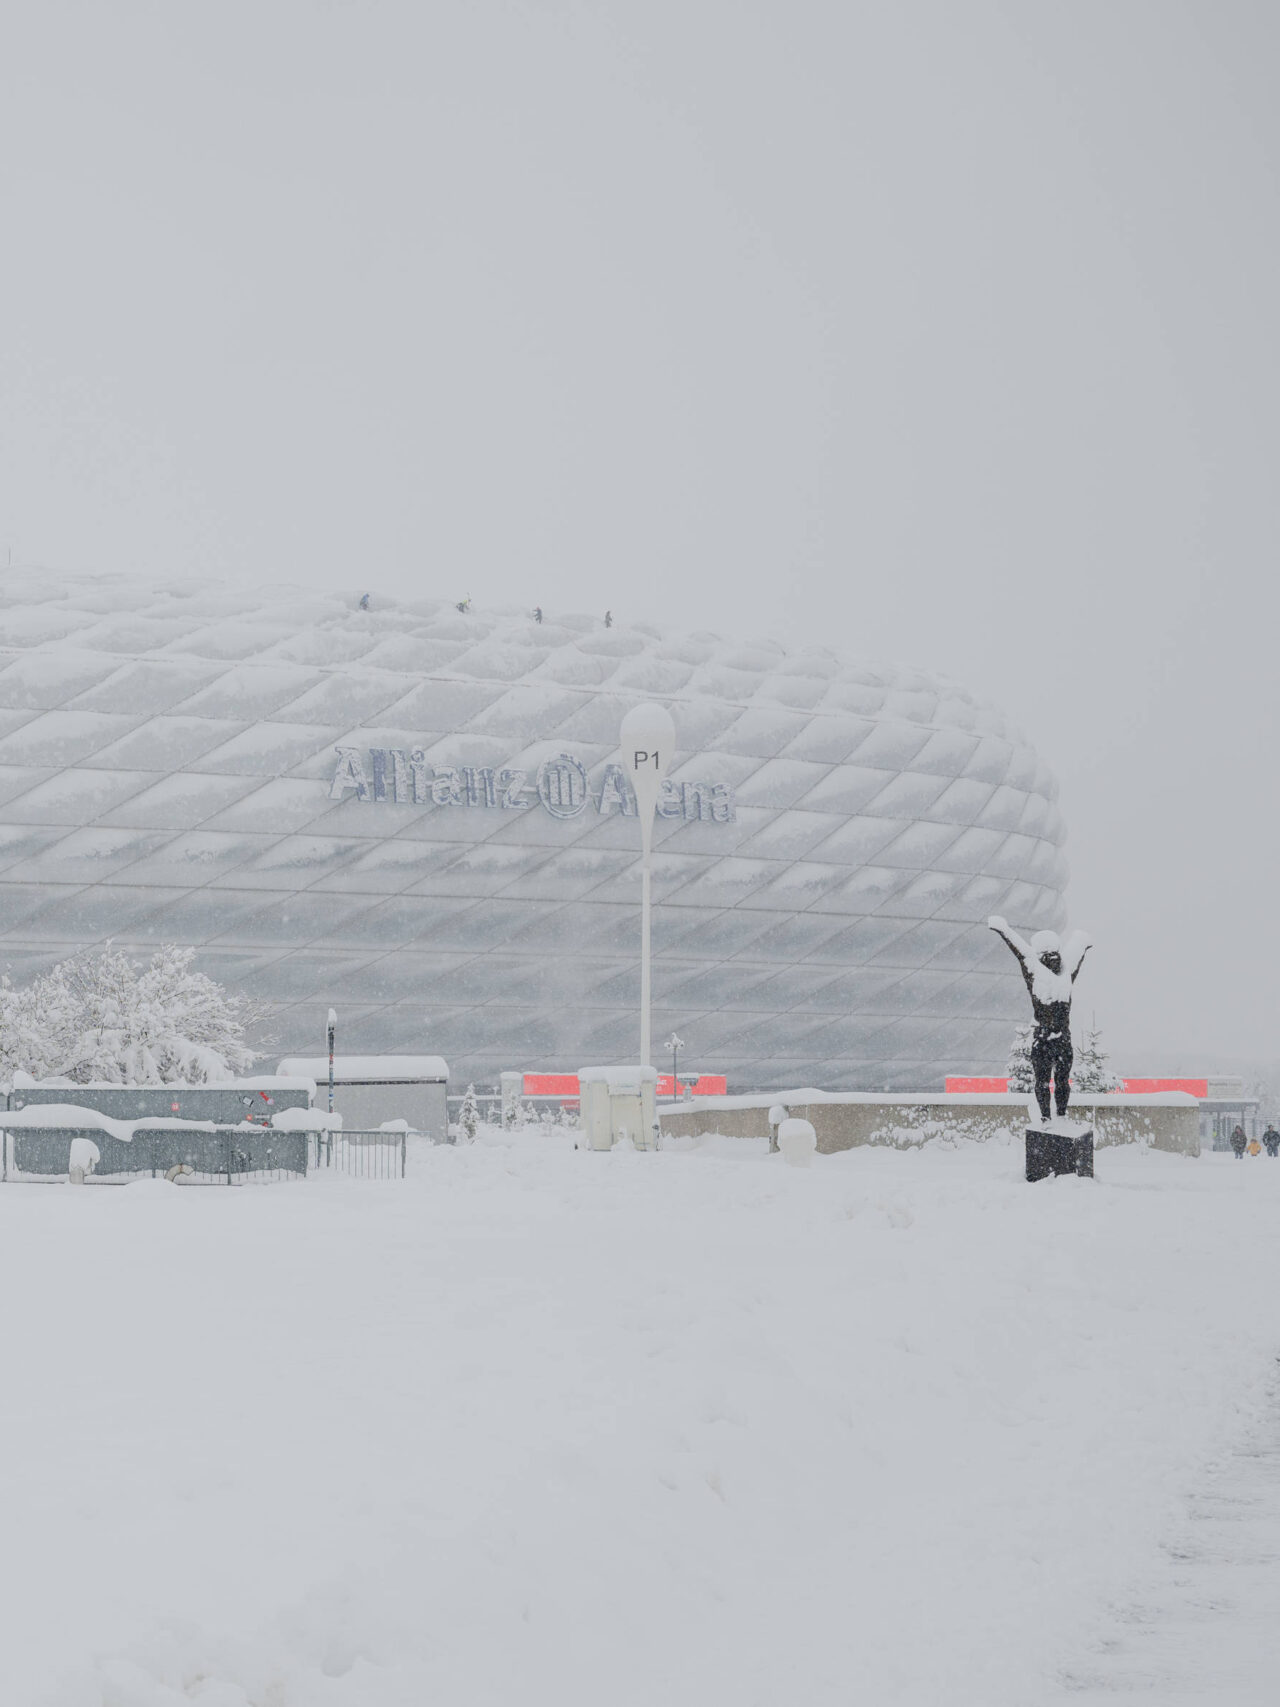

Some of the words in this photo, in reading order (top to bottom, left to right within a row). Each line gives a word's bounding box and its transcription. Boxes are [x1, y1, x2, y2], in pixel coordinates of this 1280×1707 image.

[328, 745, 529, 809] Allianz
[599, 763, 736, 824] Aena
[634, 751, 659, 770] P1
